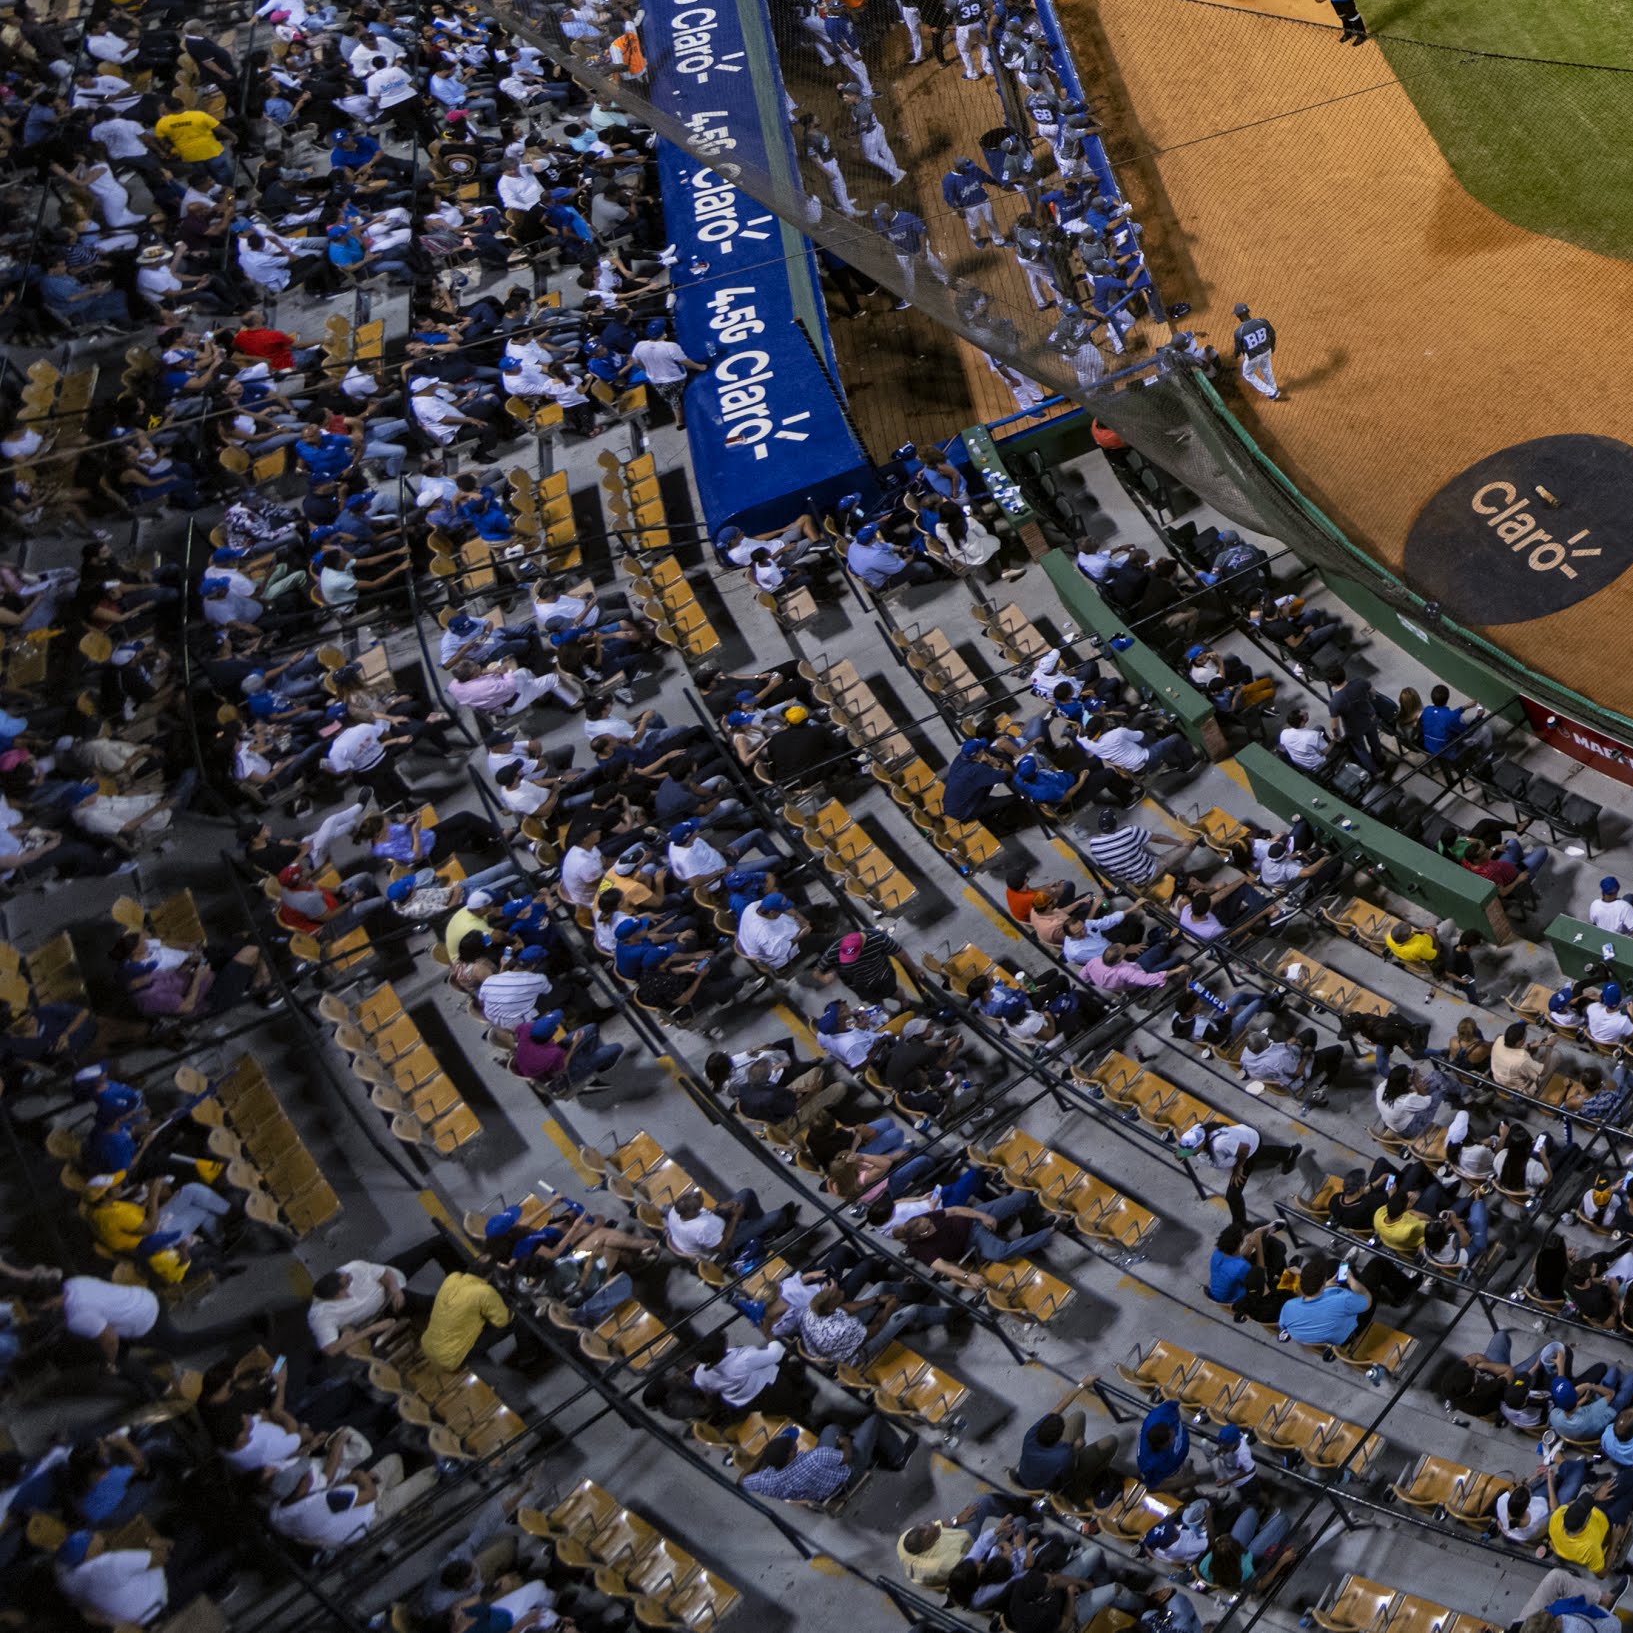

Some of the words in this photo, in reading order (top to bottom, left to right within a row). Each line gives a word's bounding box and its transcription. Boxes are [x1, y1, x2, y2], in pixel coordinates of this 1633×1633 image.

[670, 7, 718, 74] Claro
[706, 286, 766, 345] 4.5G
[715, 350, 775, 449] Claro
[1471, 480, 1567, 572] Claro
